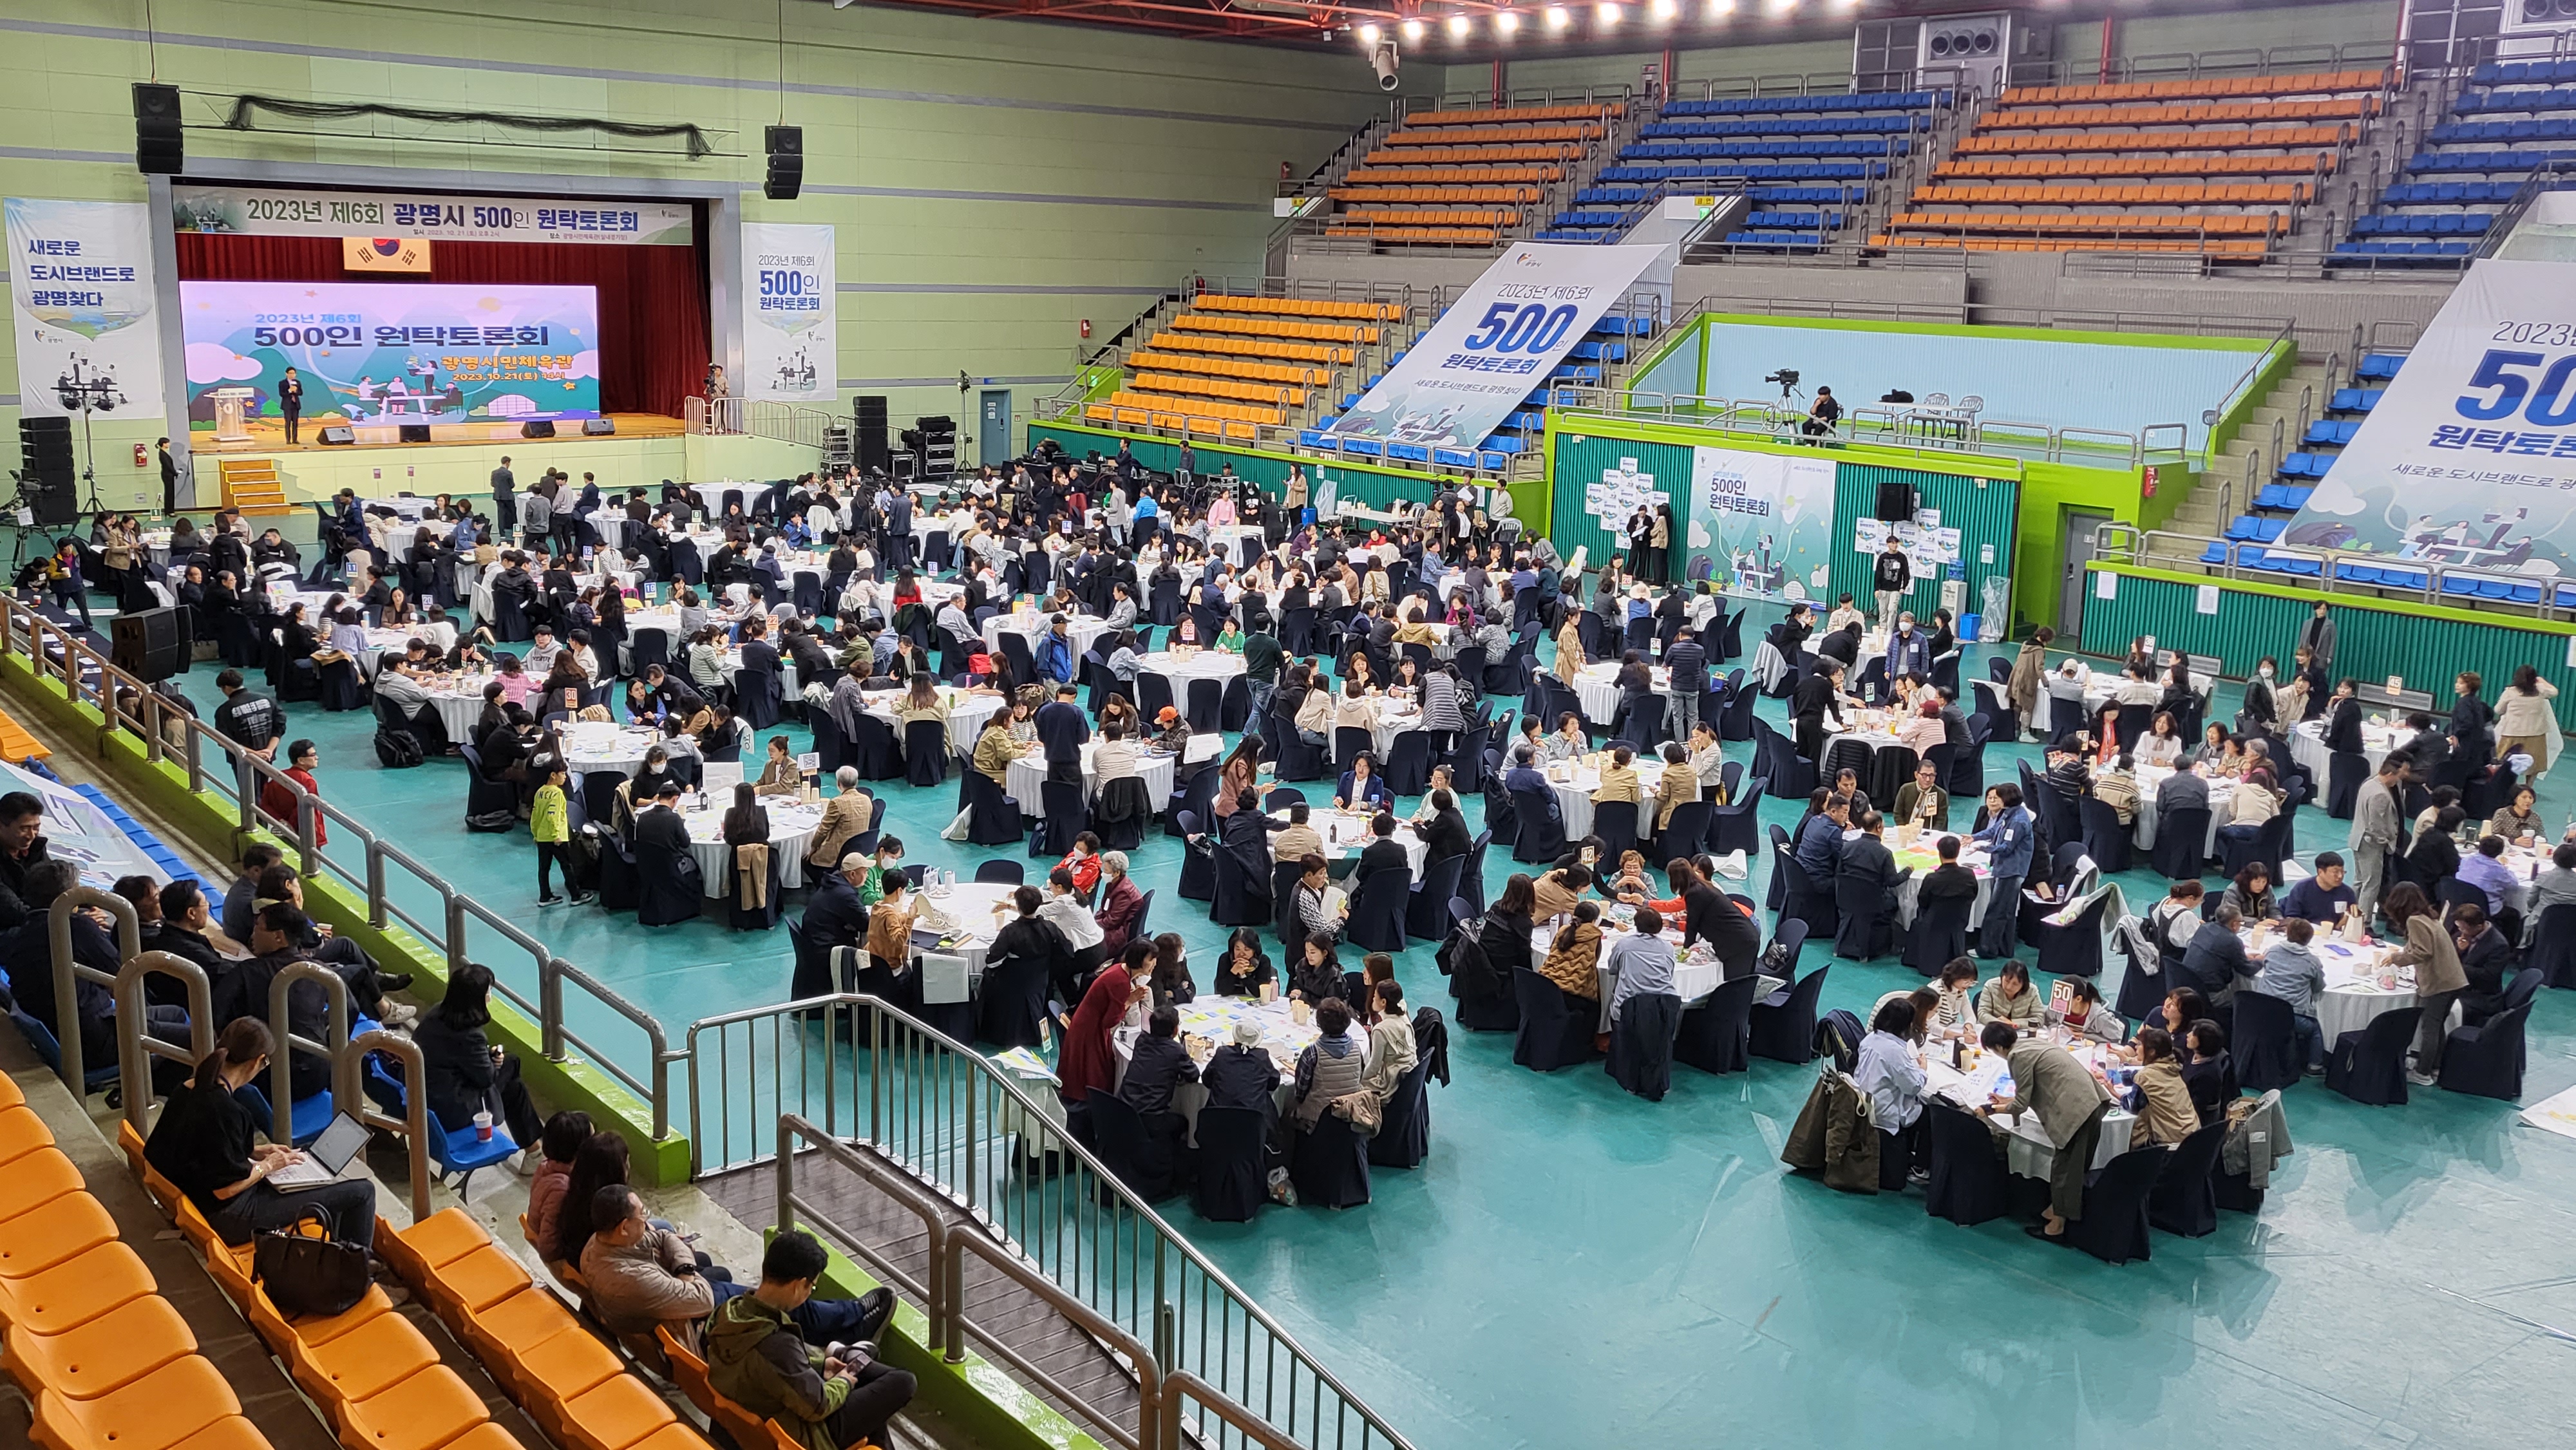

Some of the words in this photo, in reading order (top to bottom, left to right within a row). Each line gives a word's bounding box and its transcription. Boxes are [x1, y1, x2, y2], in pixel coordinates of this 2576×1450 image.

[247, 199, 322, 223] 2023년
[329, 202, 384, 225] 제6회
[393, 203, 464, 227] 광명시
[473, 206, 529, 229] 500인
[536, 209, 638, 232] 원탁토론회
[28, 239, 81, 256] 새로운
[758, 254, 789, 266] 2023년
[791, 256, 815, 267] 제6회
[30, 265, 135, 281] 도시브랜드로
[760, 270, 820, 296] 500인
[32, 290, 104, 306] 광명찾다
[1497, 283, 1548, 299] 2023년
[1549, 285, 1595, 300] 제6회
[759, 297, 820, 310] 원탁토론회
[255, 314, 314, 323] 2023년
[320, 314, 361, 323] 제6회
[254, 326, 362, 347] 500인
[374, 325, 549, 347] 원탁토론회
[2492, 321, 2576, 347] 2023
[441, 354, 574, 372] 광명시민체육관
[1441, 353, 1542, 375] 원탁토론회
[1414, 379, 1441, 388] 새로운
[2392, 463, 2445, 478] 새로운
[2445, 469, 2554, 487] 도시브랜드로
[1710, 477, 1747, 496] 500인
[1709, 493, 1770, 517] 원탁토론회
[767, 616, 777, 625] 22
[1184, 625, 1194, 634] 28
[1652, 639, 1660, 648] 34
[1866, 684, 1873, 694] 37
[2390, 678, 2400, 687] 45
[566, 691, 576, 701] 30
[1927, 794, 1935, 807] 43
[1582, 848, 1593, 862] 42
[2054, 984, 2070, 1001] 50
